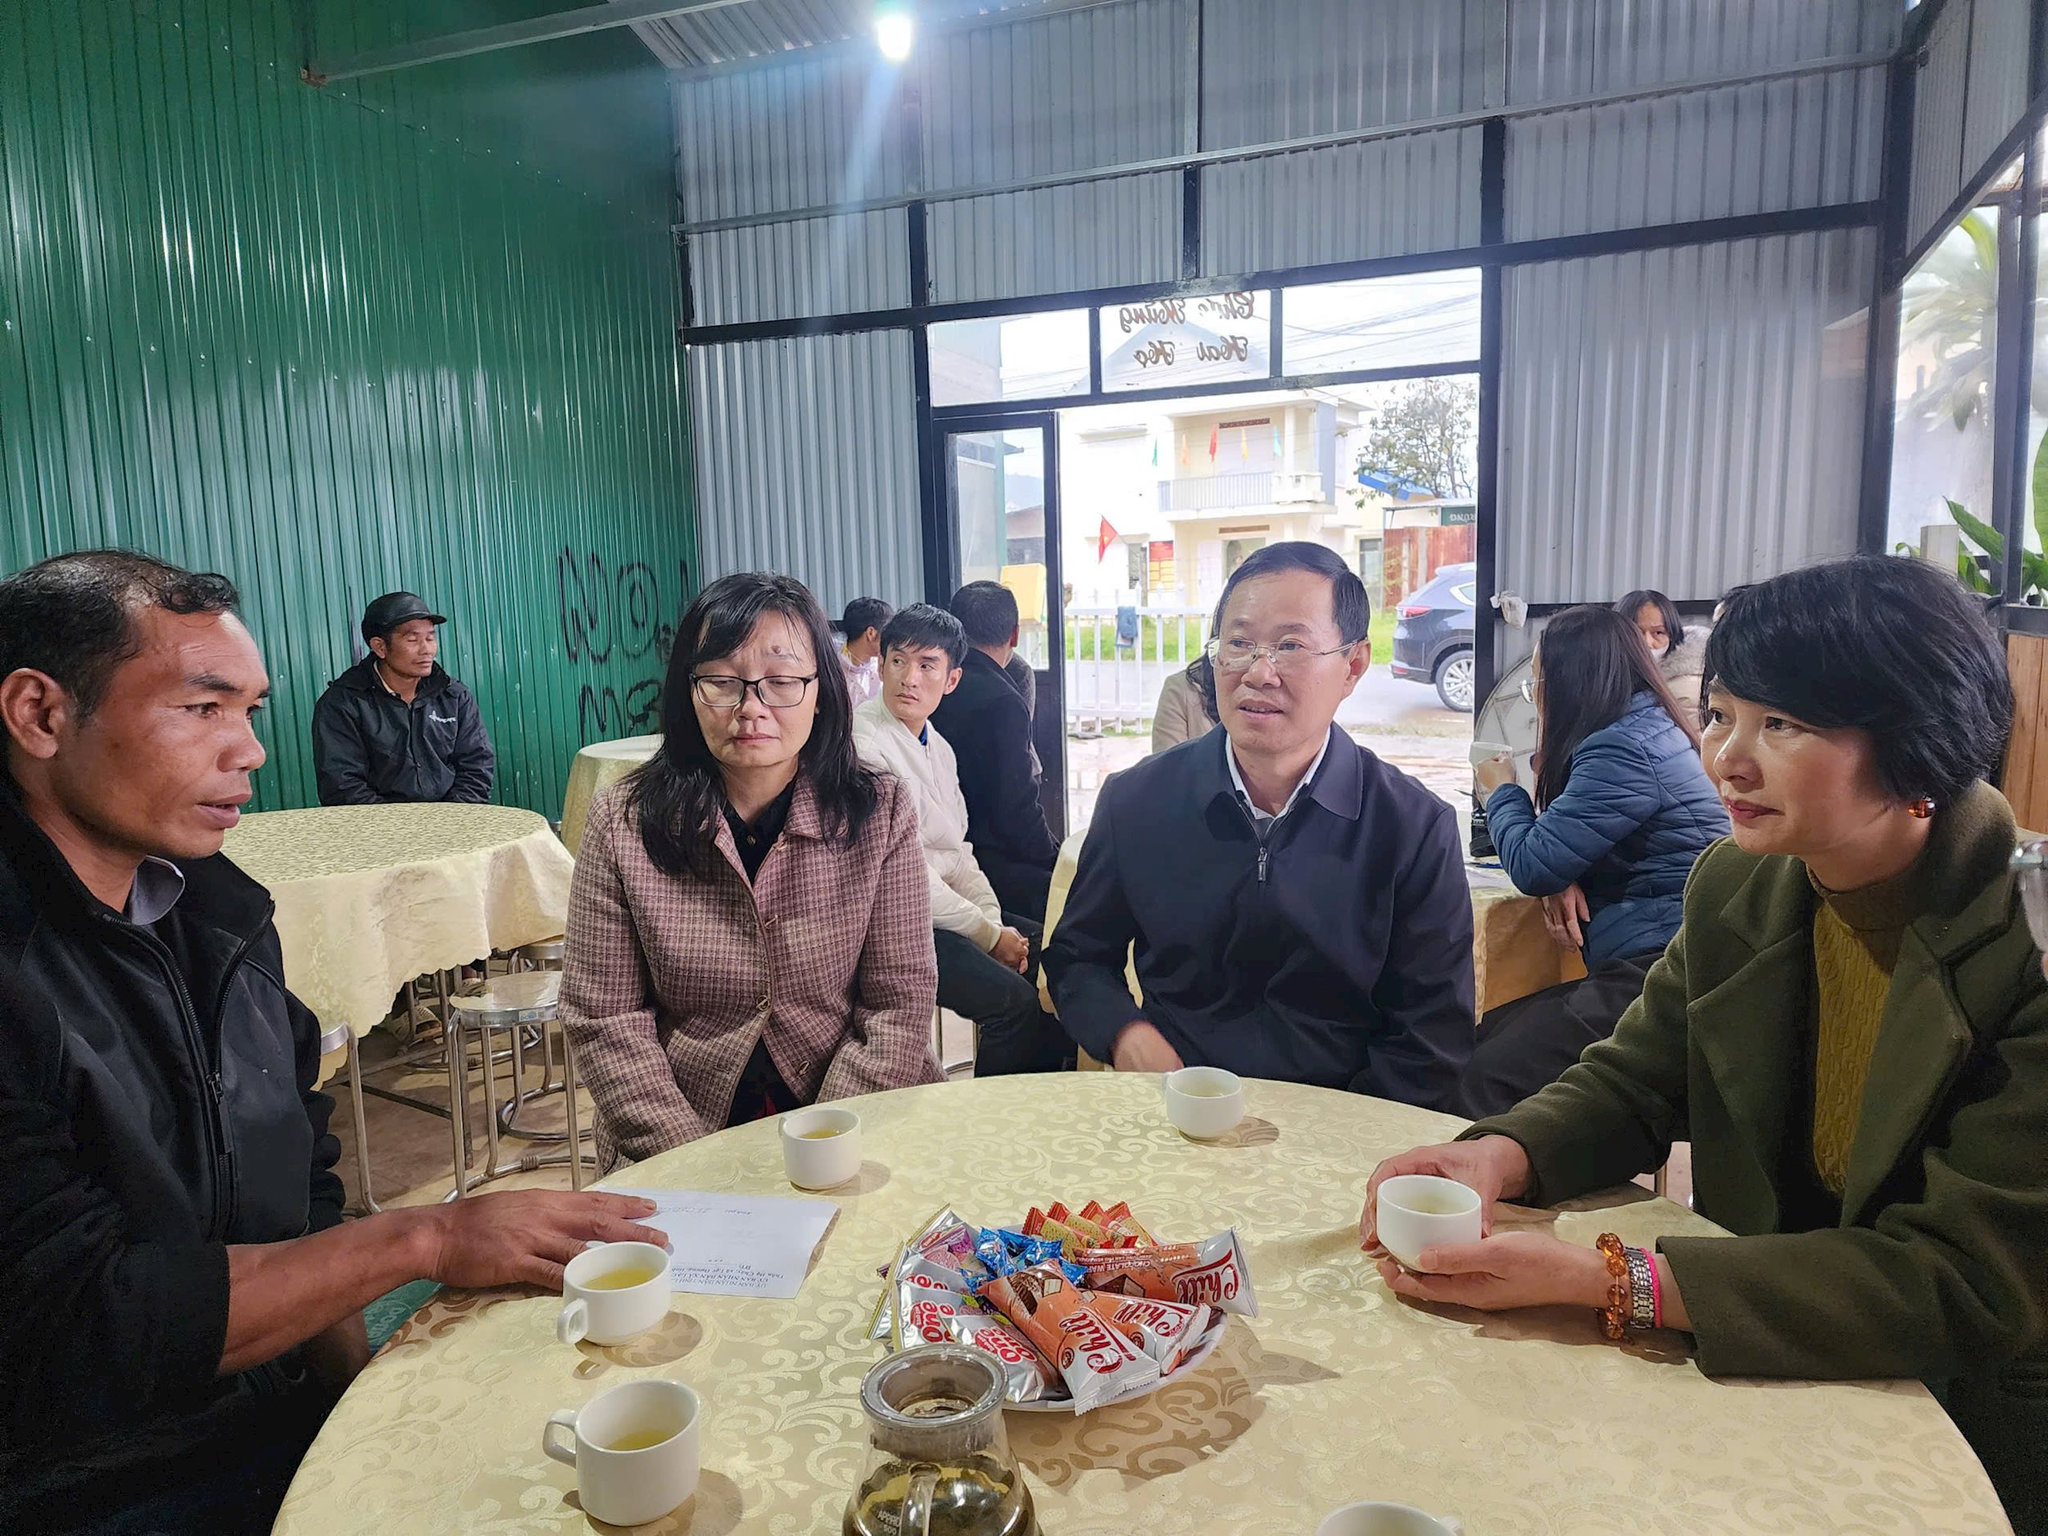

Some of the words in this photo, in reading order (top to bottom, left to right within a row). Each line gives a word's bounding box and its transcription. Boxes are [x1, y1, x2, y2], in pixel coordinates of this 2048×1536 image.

[1175, 1264, 1239, 1305] Chill
[1113, 1301, 1186, 1338] Chill
[1059, 1312, 1124, 1375] Chill
